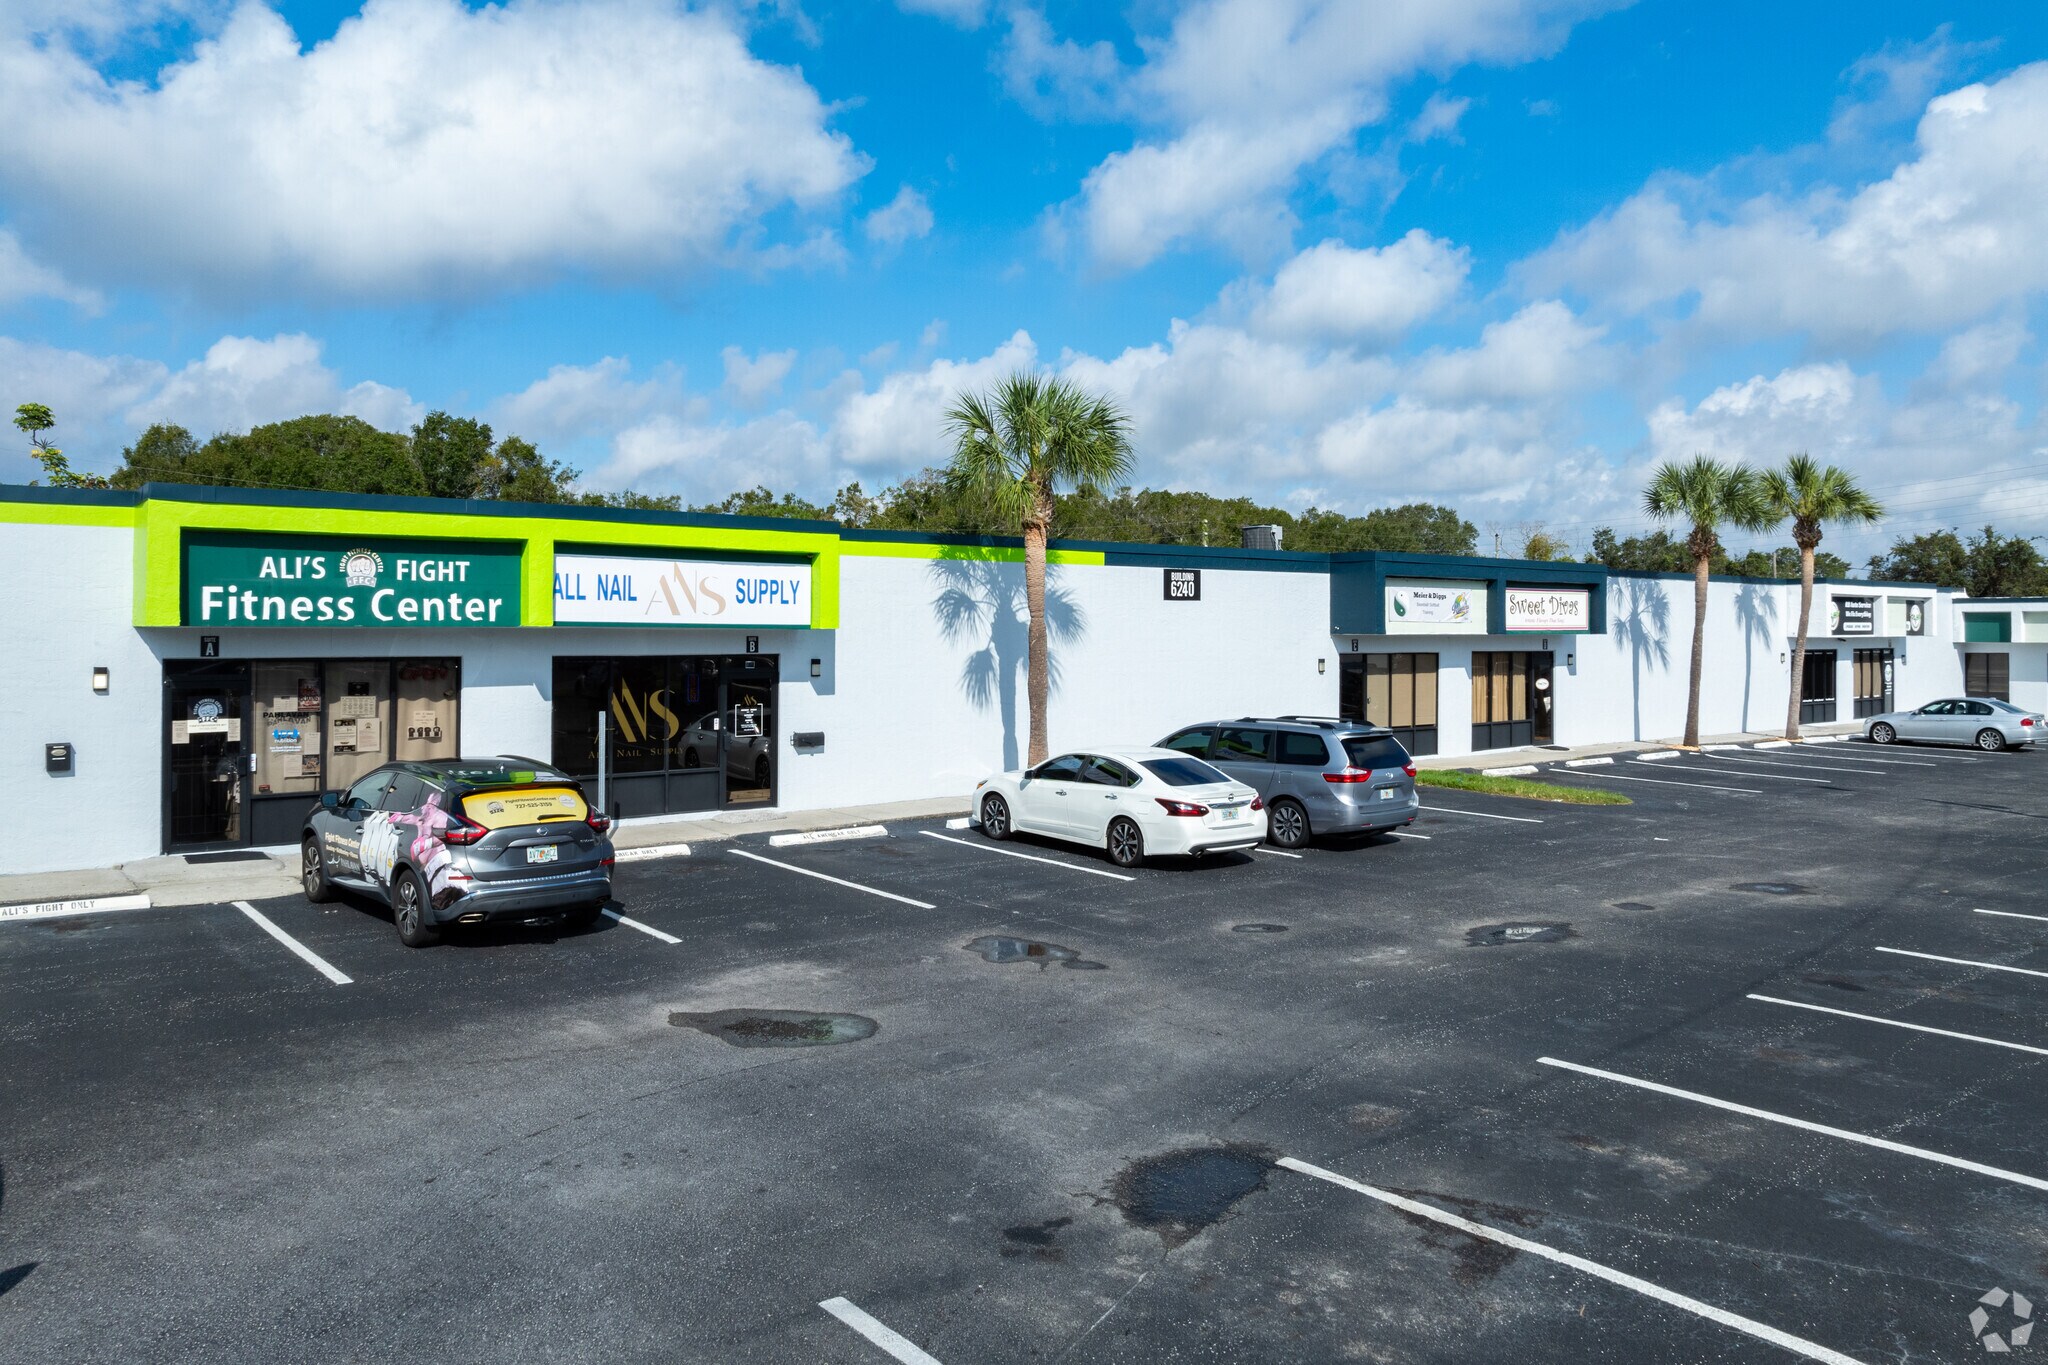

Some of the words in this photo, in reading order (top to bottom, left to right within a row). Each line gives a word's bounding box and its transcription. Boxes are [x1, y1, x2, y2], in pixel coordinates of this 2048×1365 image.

[259, 556, 326, 579] ALI'S
[397, 559, 470, 582] FIGHT
[1171, 571, 1195, 581] BUILDING
[352, 576, 371, 585] FFC
[554, 573, 587, 600] ALL
[597, 573, 638, 601] NAIL
[645, 562, 727, 616] ANS
[736, 578, 800, 604] SUPPLY
[1171, 581, 1195, 597] 6240
[202, 585, 355, 622] Fitness
[371, 588, 502, 622] Center
[1509, 594, 1546, 615] Sweet
[1549, 595, 1579, 616] Divas
[206, 642, 214, 656] A
[749, 641, 756, 652] B
[263, 711, 310, 719] PAHLAVAN
[2, 906, 28, 916] ALI'S
[35, 903, 65, 913] FIGHT
[71, 900, 95, 910] ONLY
